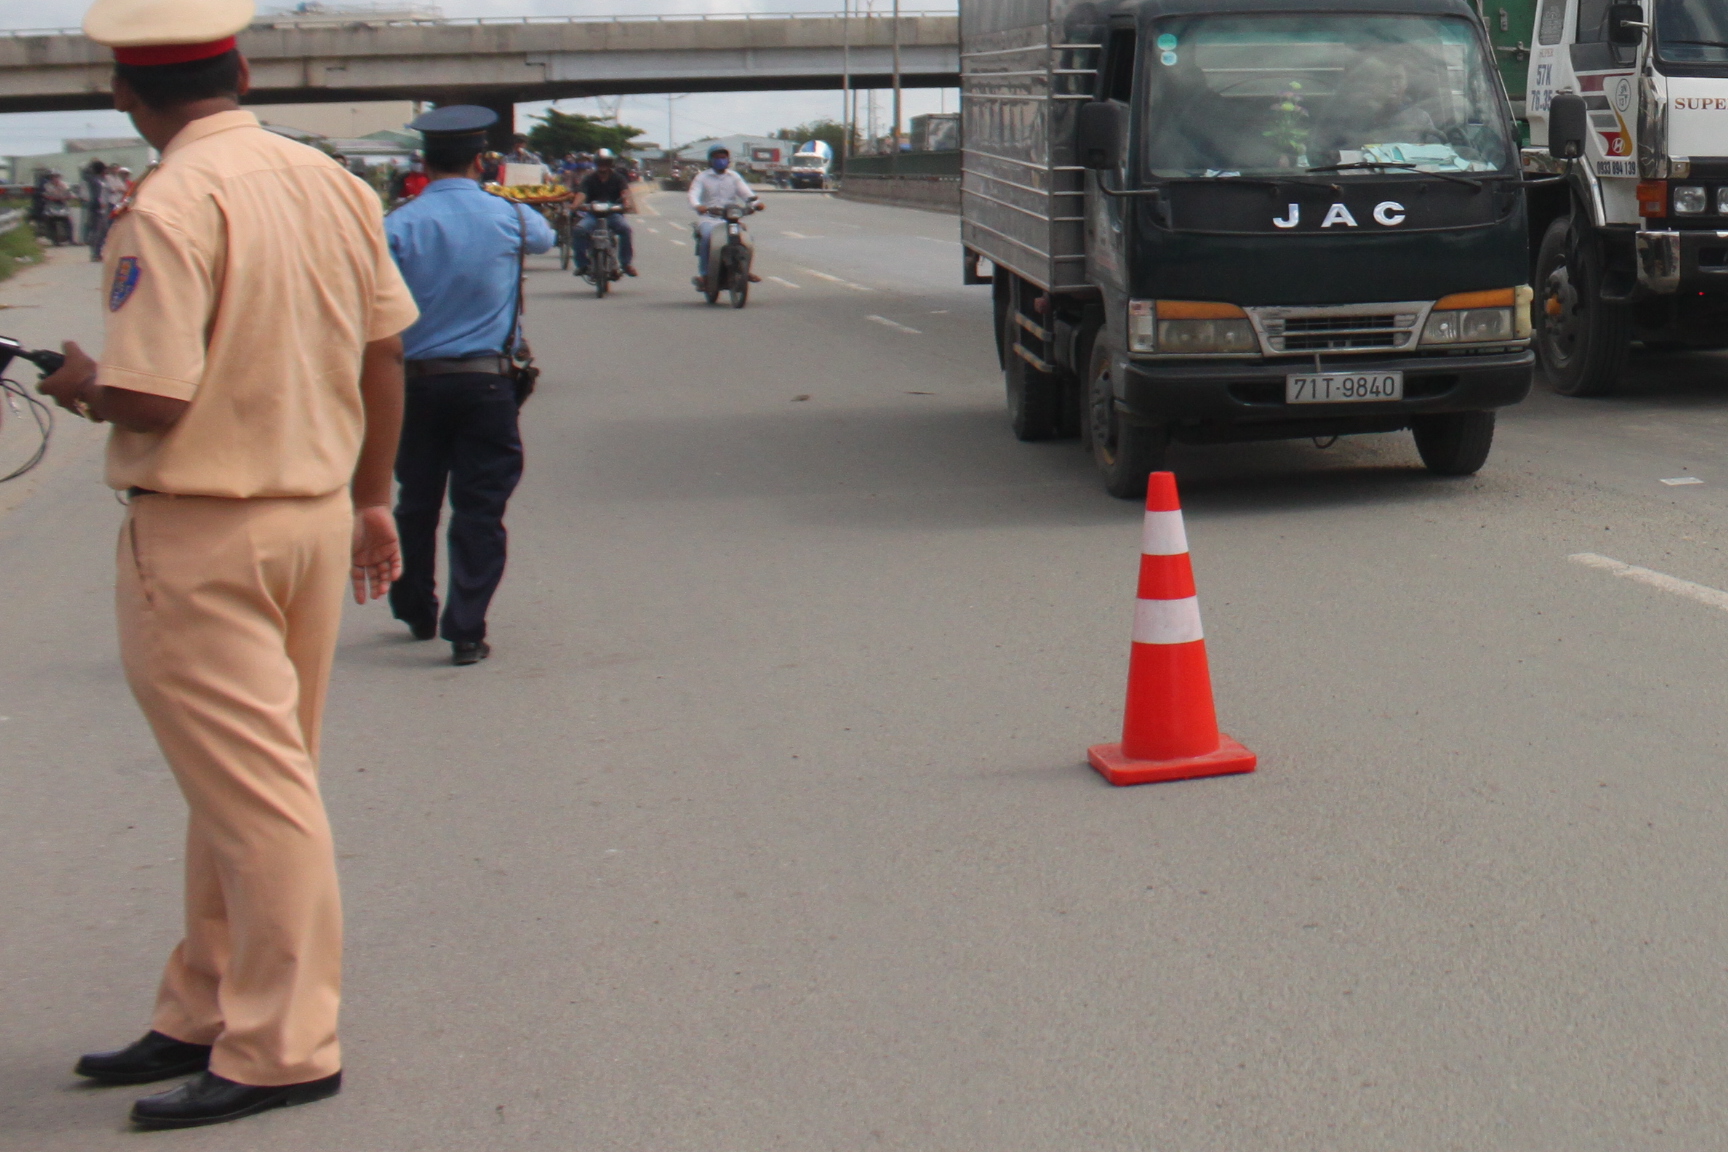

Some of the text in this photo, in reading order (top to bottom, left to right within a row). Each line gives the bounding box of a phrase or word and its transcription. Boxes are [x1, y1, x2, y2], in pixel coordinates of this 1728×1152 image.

[1625, 161, 1636, 176] 139
[1272, 201, 1406, 228] JAC
[1294, 376, 1395, 400] 71T-9840
